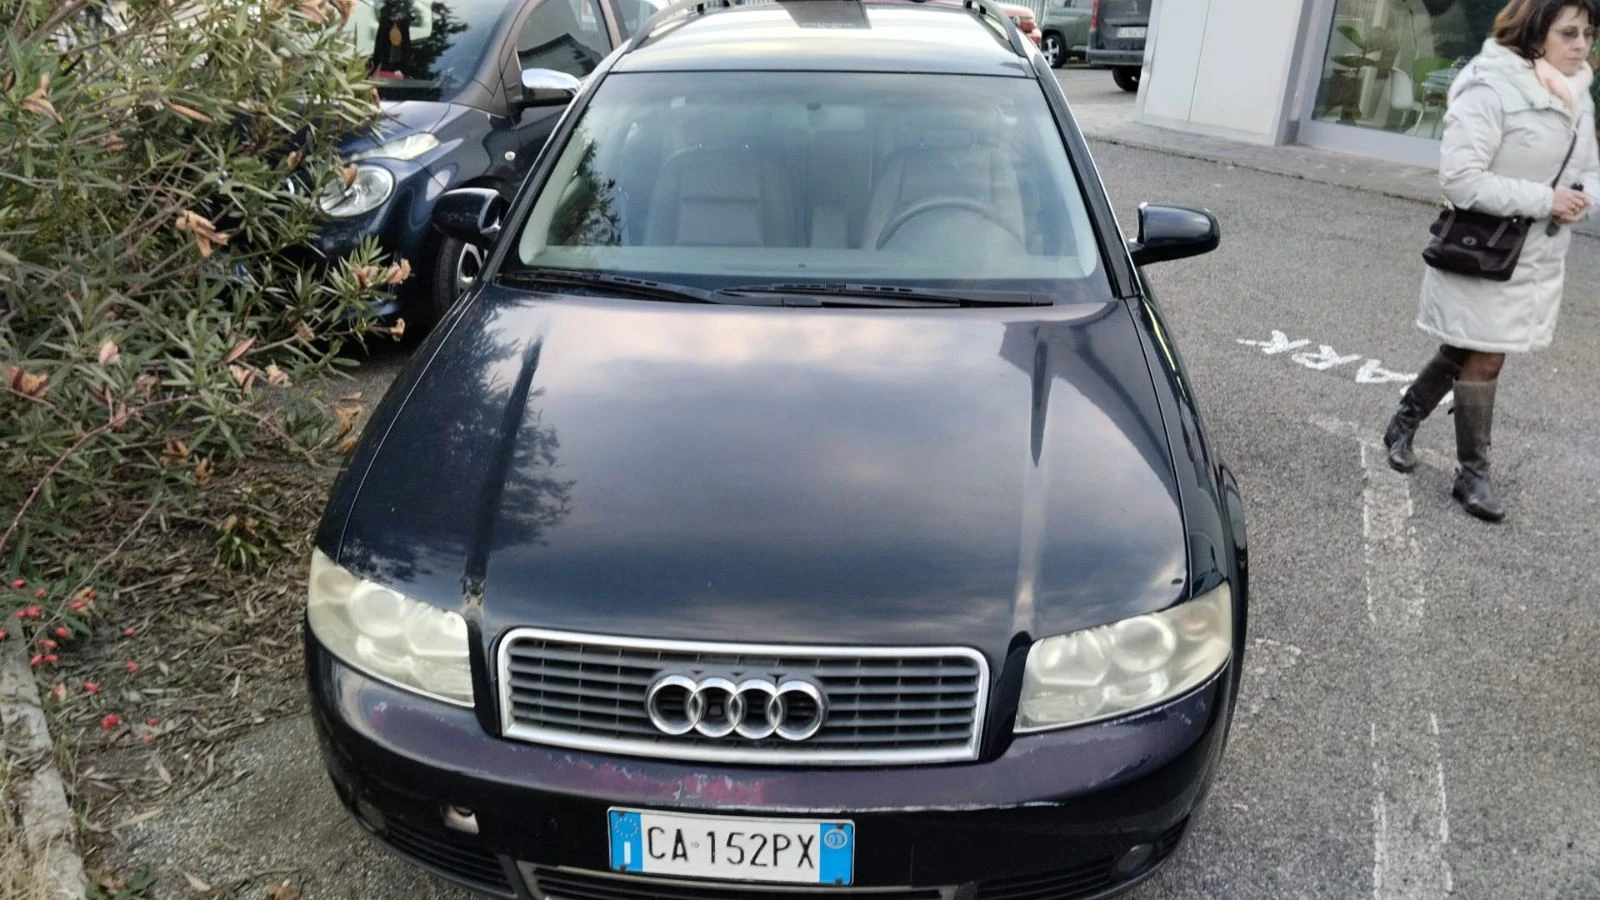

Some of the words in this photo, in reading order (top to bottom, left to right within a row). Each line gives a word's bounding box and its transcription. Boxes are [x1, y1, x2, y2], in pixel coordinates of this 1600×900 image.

[624, 841, 631, 864] I
[648, 827, 689, 862] CA
[707, 831, 815, 869] 152PX
